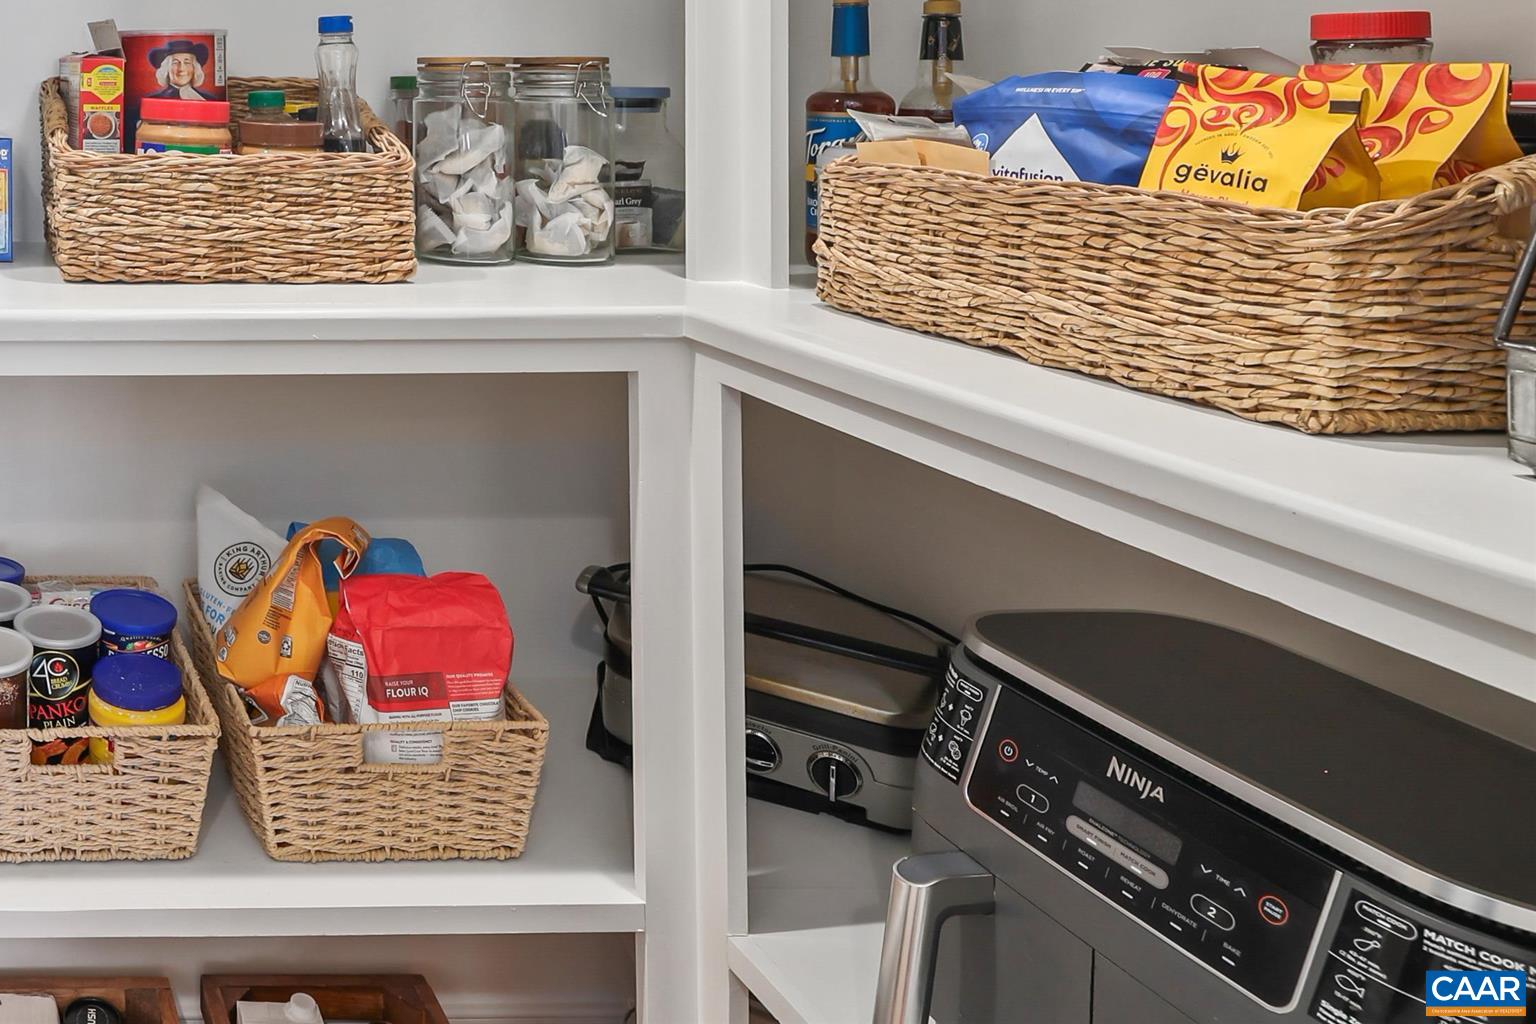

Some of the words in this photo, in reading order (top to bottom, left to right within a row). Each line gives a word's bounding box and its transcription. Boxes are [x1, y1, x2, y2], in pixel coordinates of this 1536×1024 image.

[991, 165, 1064, 182] vitafusion
[1173, 163, 1268, 193] gëvalia
[226, 545, 248, 557] KING
[250, 546, 268, 576] ARTHUR
[206, 605, 225, 625] FOR
[32, 657, 69, 695] 4C
[51, 676, 68, 684] BREAD
[351, 670, 364, 679] 110
[386, 687, 417, 698] FLOUR
[418, 686, 429, 697] IQ
[29, 696, 87, 720] PANKO
[43, 716, 76, 728] PLAIN
[1106, 755, 1165, 803] NINJA
[1077, 847, 1096, 862] ROAST
[1120, 875, 1142, 893] REHEAT
[1215, 874, 1231, 887] TIME
[1161, 902, 1198, 929] DEHYDRATE
[1207, 906, 1217, 919] 2
[1222, 941, 1242, 957] BAKE
[1423, 928, 1476, 957] MATCH
[1479, 950, 1525, 972] COOK
